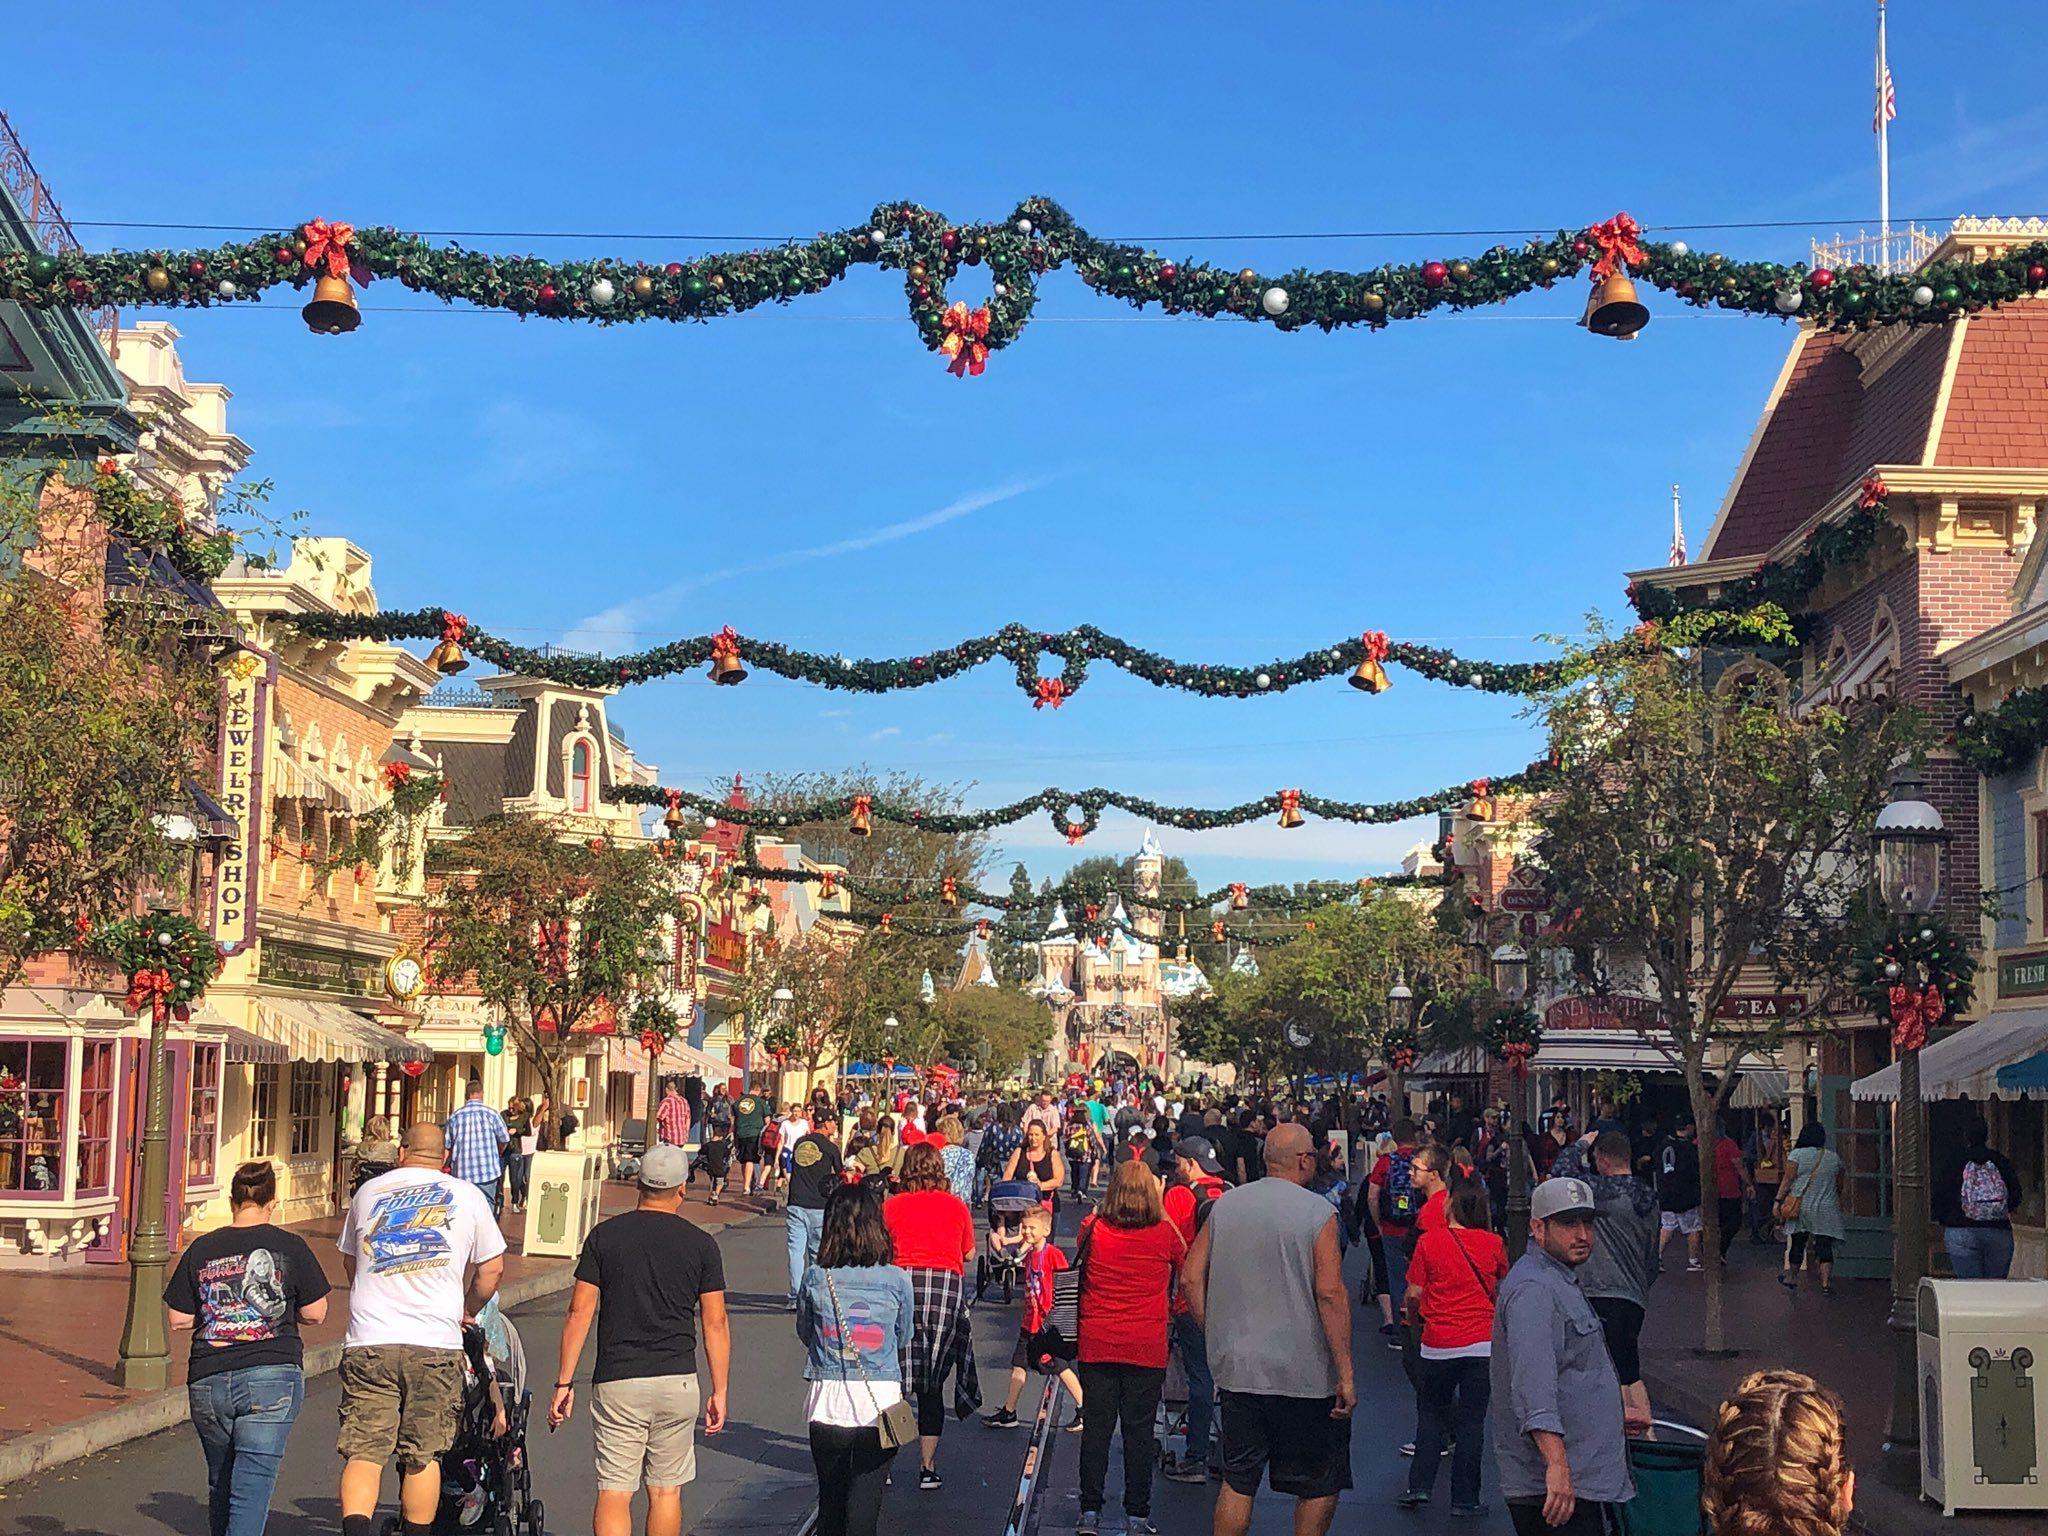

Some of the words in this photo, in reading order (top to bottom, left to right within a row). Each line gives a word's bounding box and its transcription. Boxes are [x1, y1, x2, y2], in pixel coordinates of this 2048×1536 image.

[222, 843, 242, 925] SHOP
[2015, 965, 2045, 984] FRESH
[1734, 1000, 1776, 1015] TEA
[368, 1190, 446, 1219] FORCE
[200, 1262, 247, 1282] FORCE
